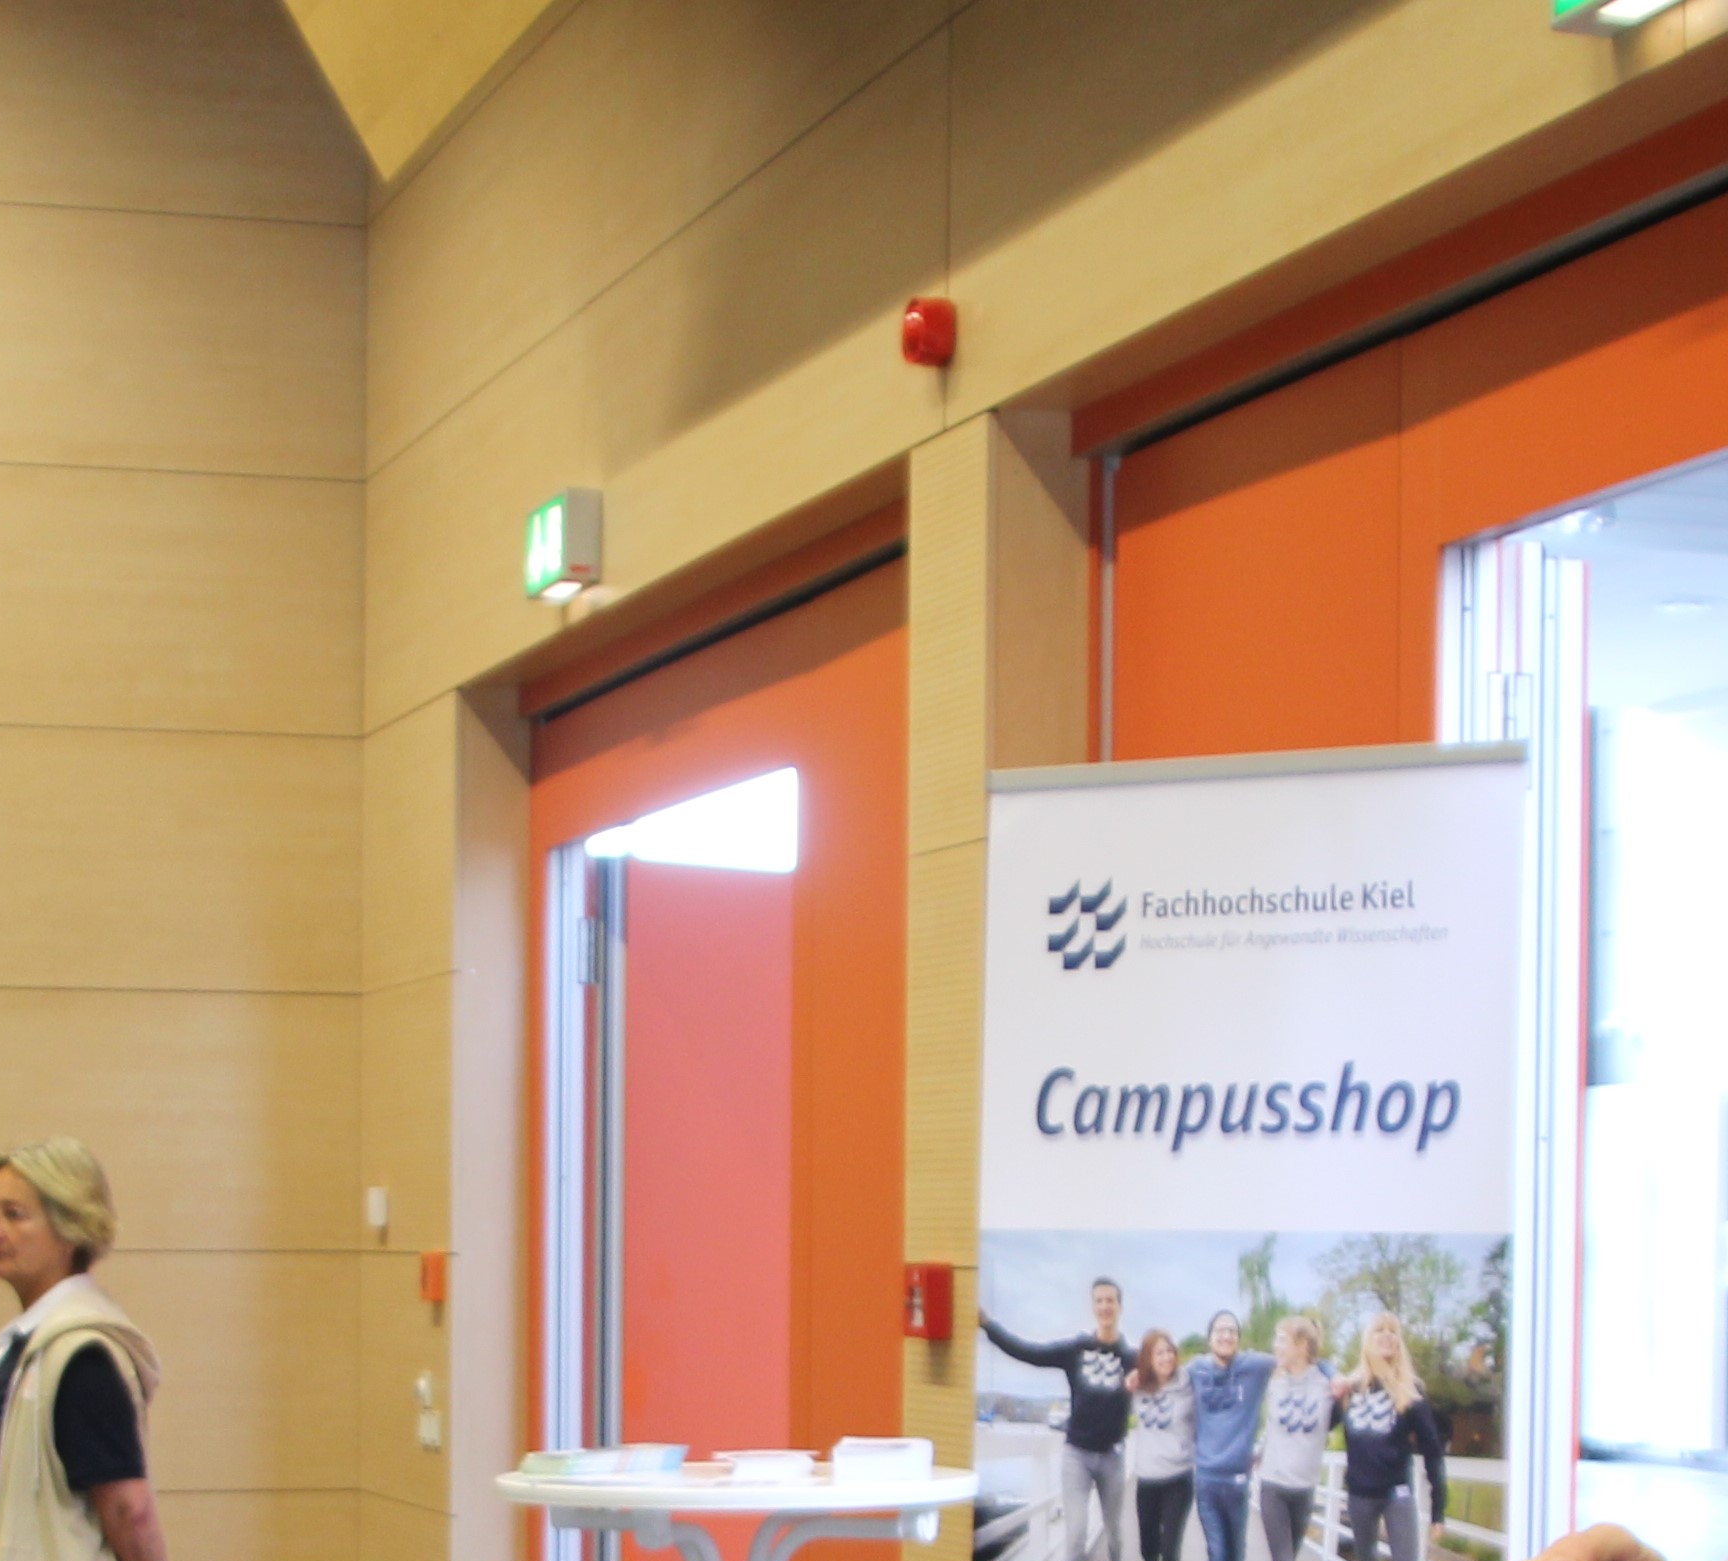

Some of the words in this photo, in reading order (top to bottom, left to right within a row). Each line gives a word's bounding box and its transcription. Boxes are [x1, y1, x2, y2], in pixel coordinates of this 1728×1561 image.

[1141, 883, 1354, 918] Fachhochschule
[1361, 880, 1415, 910] Kiel
[1035, 1059, 1462, 1152] Campusshop
